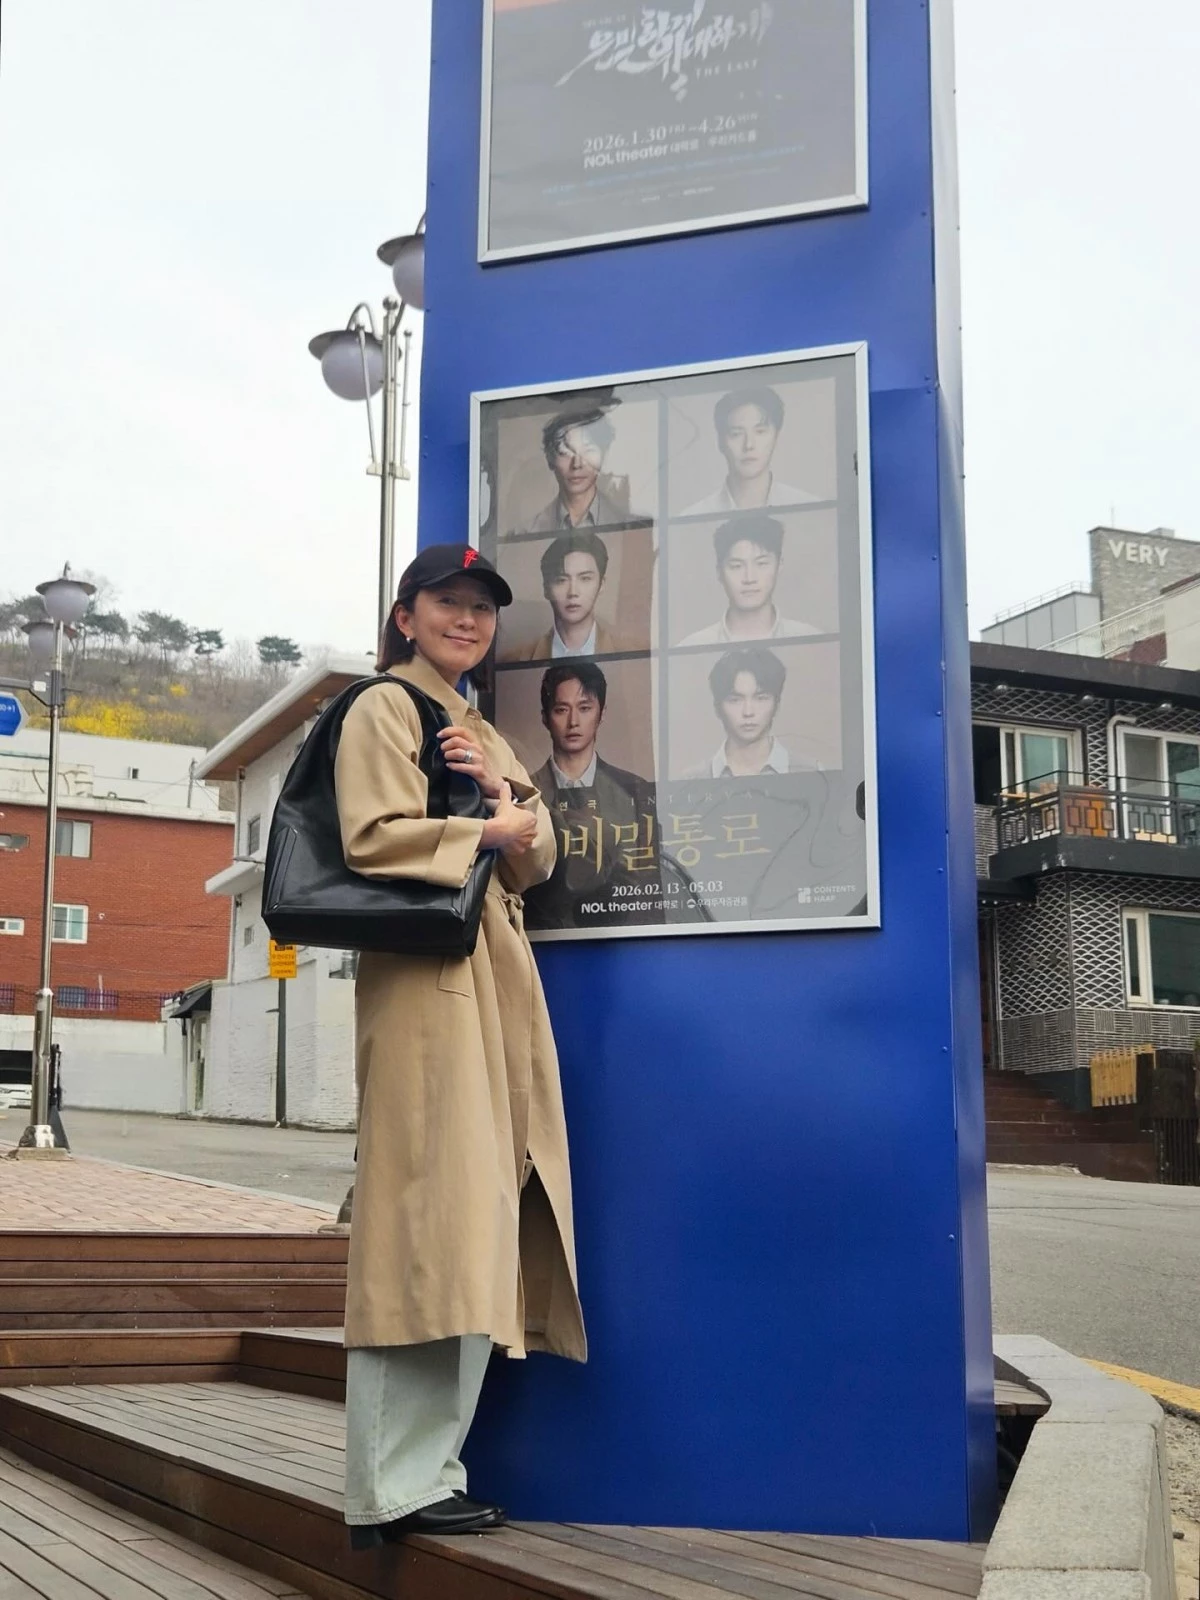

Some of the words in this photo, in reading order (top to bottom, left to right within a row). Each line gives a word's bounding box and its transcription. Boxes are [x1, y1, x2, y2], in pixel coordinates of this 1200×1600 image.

[582, 125, 667, 154] 2026.1.30
[583, 152, 615, 169] NOL
[615, 144, 669, 163] theater
[1108, 539, 1170, 567] VERY
[560, 812, 772, 875] 비밀통로
[689, 880, 724, 894] 05.03
[580, 901, 608, 915] NOL
[608, 899, 653, 913] theater
